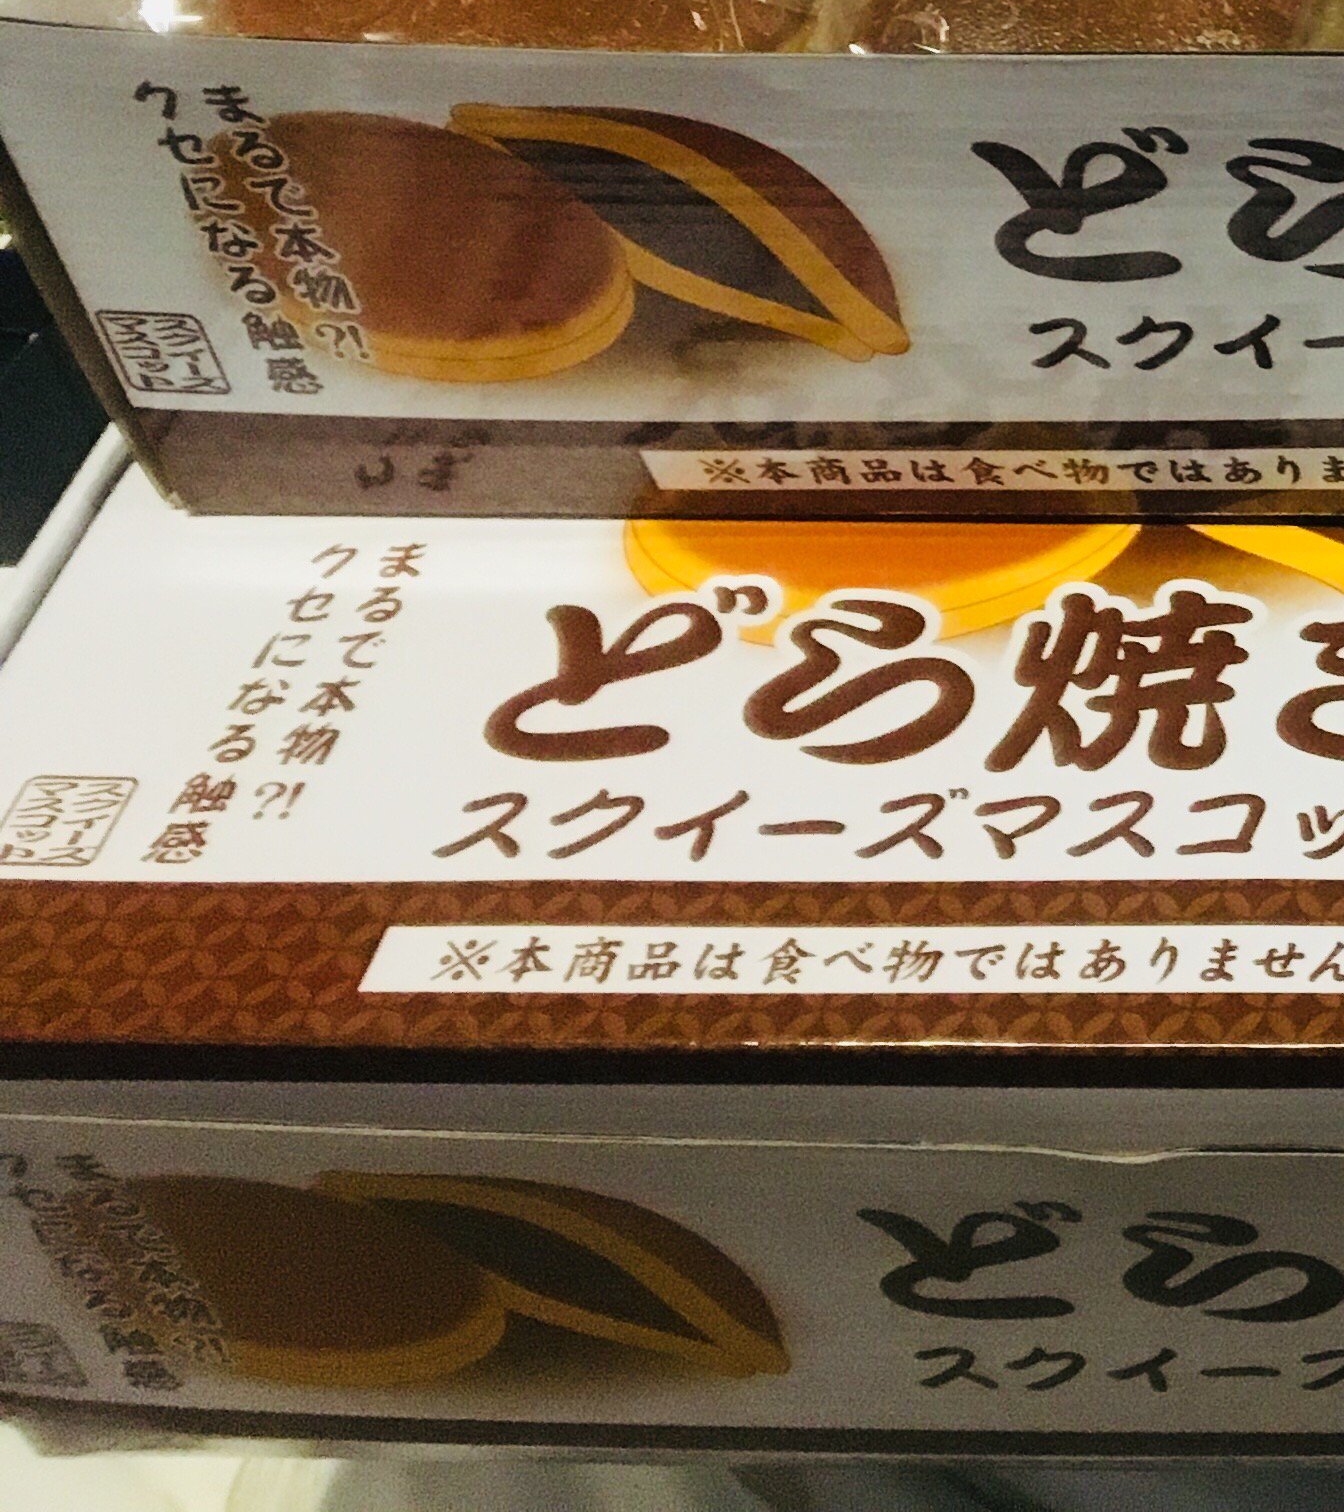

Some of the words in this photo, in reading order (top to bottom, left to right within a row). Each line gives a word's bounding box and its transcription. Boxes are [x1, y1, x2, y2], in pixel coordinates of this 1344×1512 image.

[134, 81, 324, 394] クセになる触感
[203, 84, 371, 360] まるで本物?!
[140, 542, 360, 866] クセになる触感
[251, 542, 428, 822] まるで本物?!
